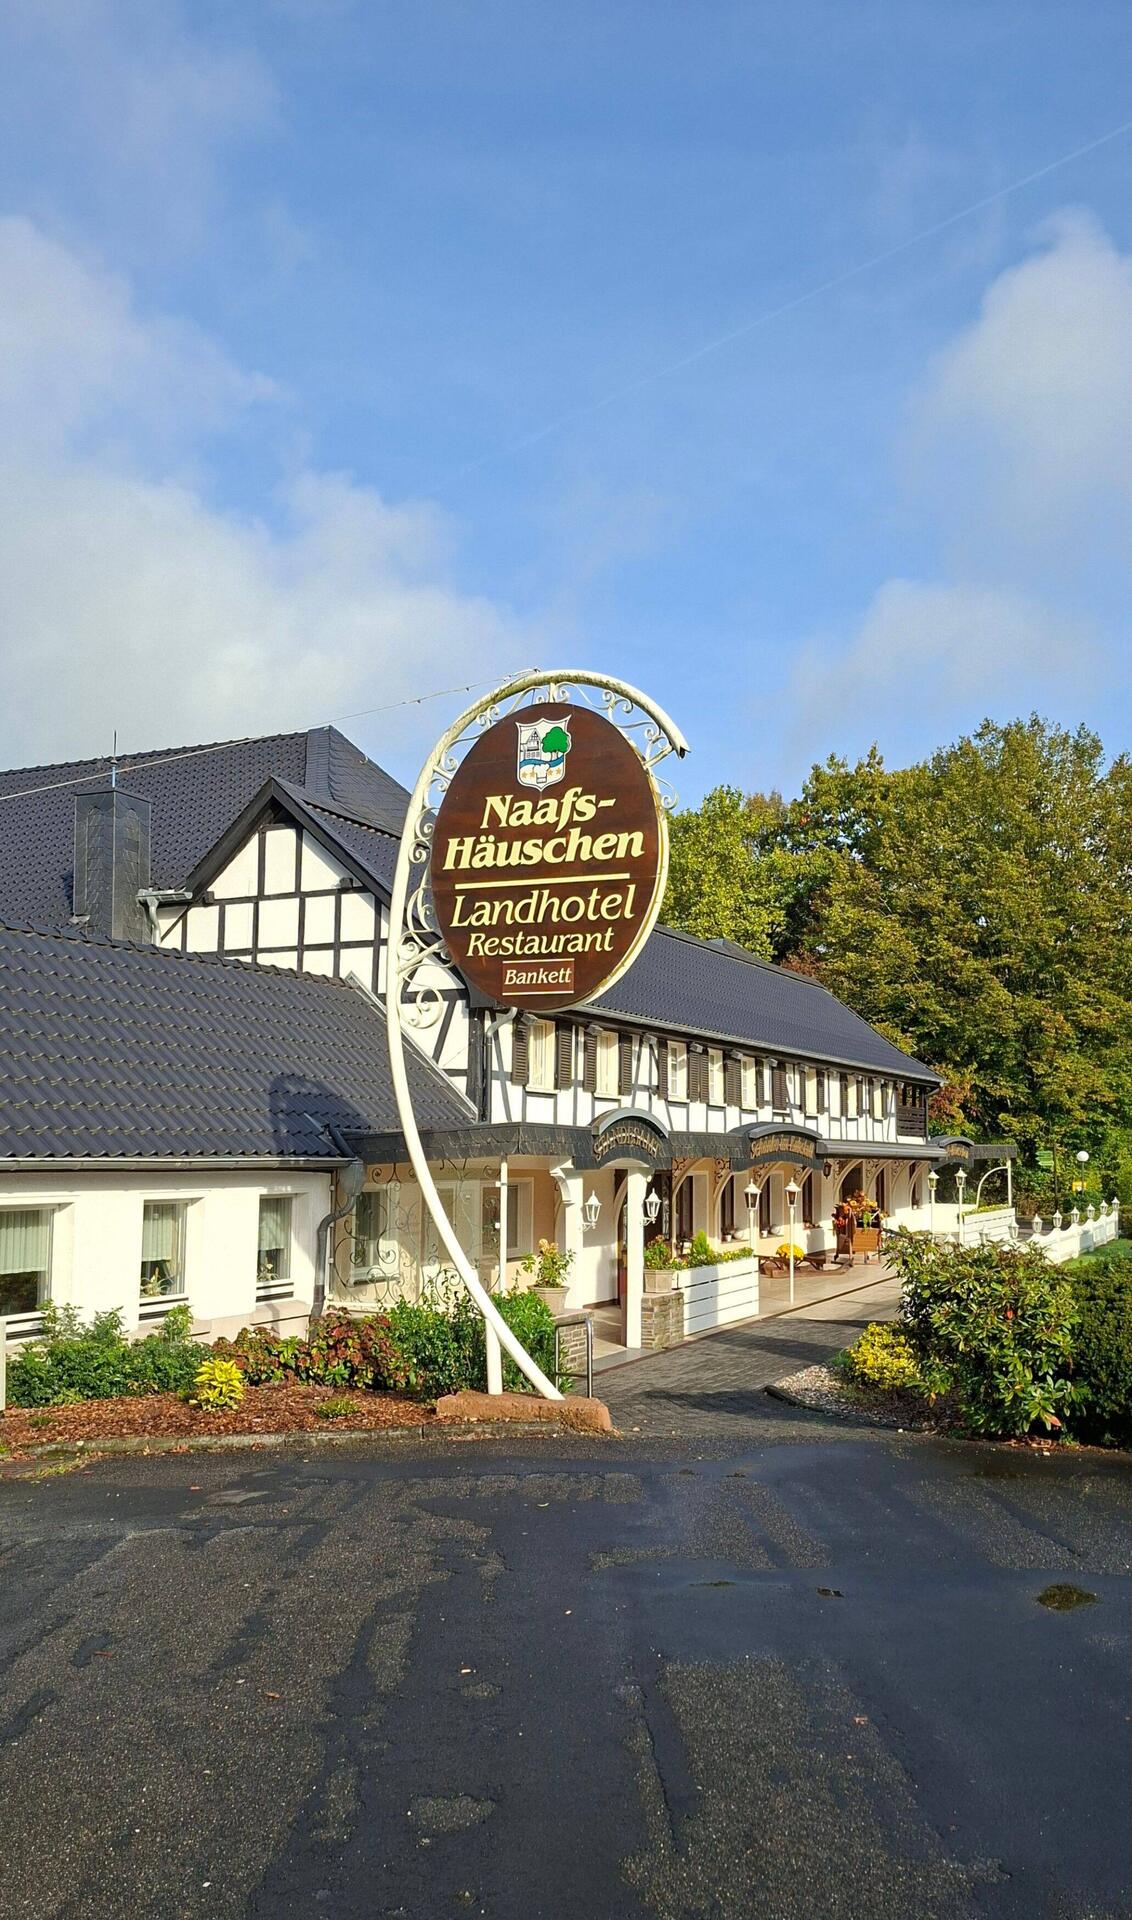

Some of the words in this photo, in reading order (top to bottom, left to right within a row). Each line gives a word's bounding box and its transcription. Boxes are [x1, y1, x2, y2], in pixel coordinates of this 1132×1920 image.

[480, 787, 616, 833] Naafs-
[443, 827, 644, 870] Häuschen
[450, 885, 635, 926] Landhotel
[467, 928, 614, 956] Restaurant
[505, 968, 572, 985] Bankett
